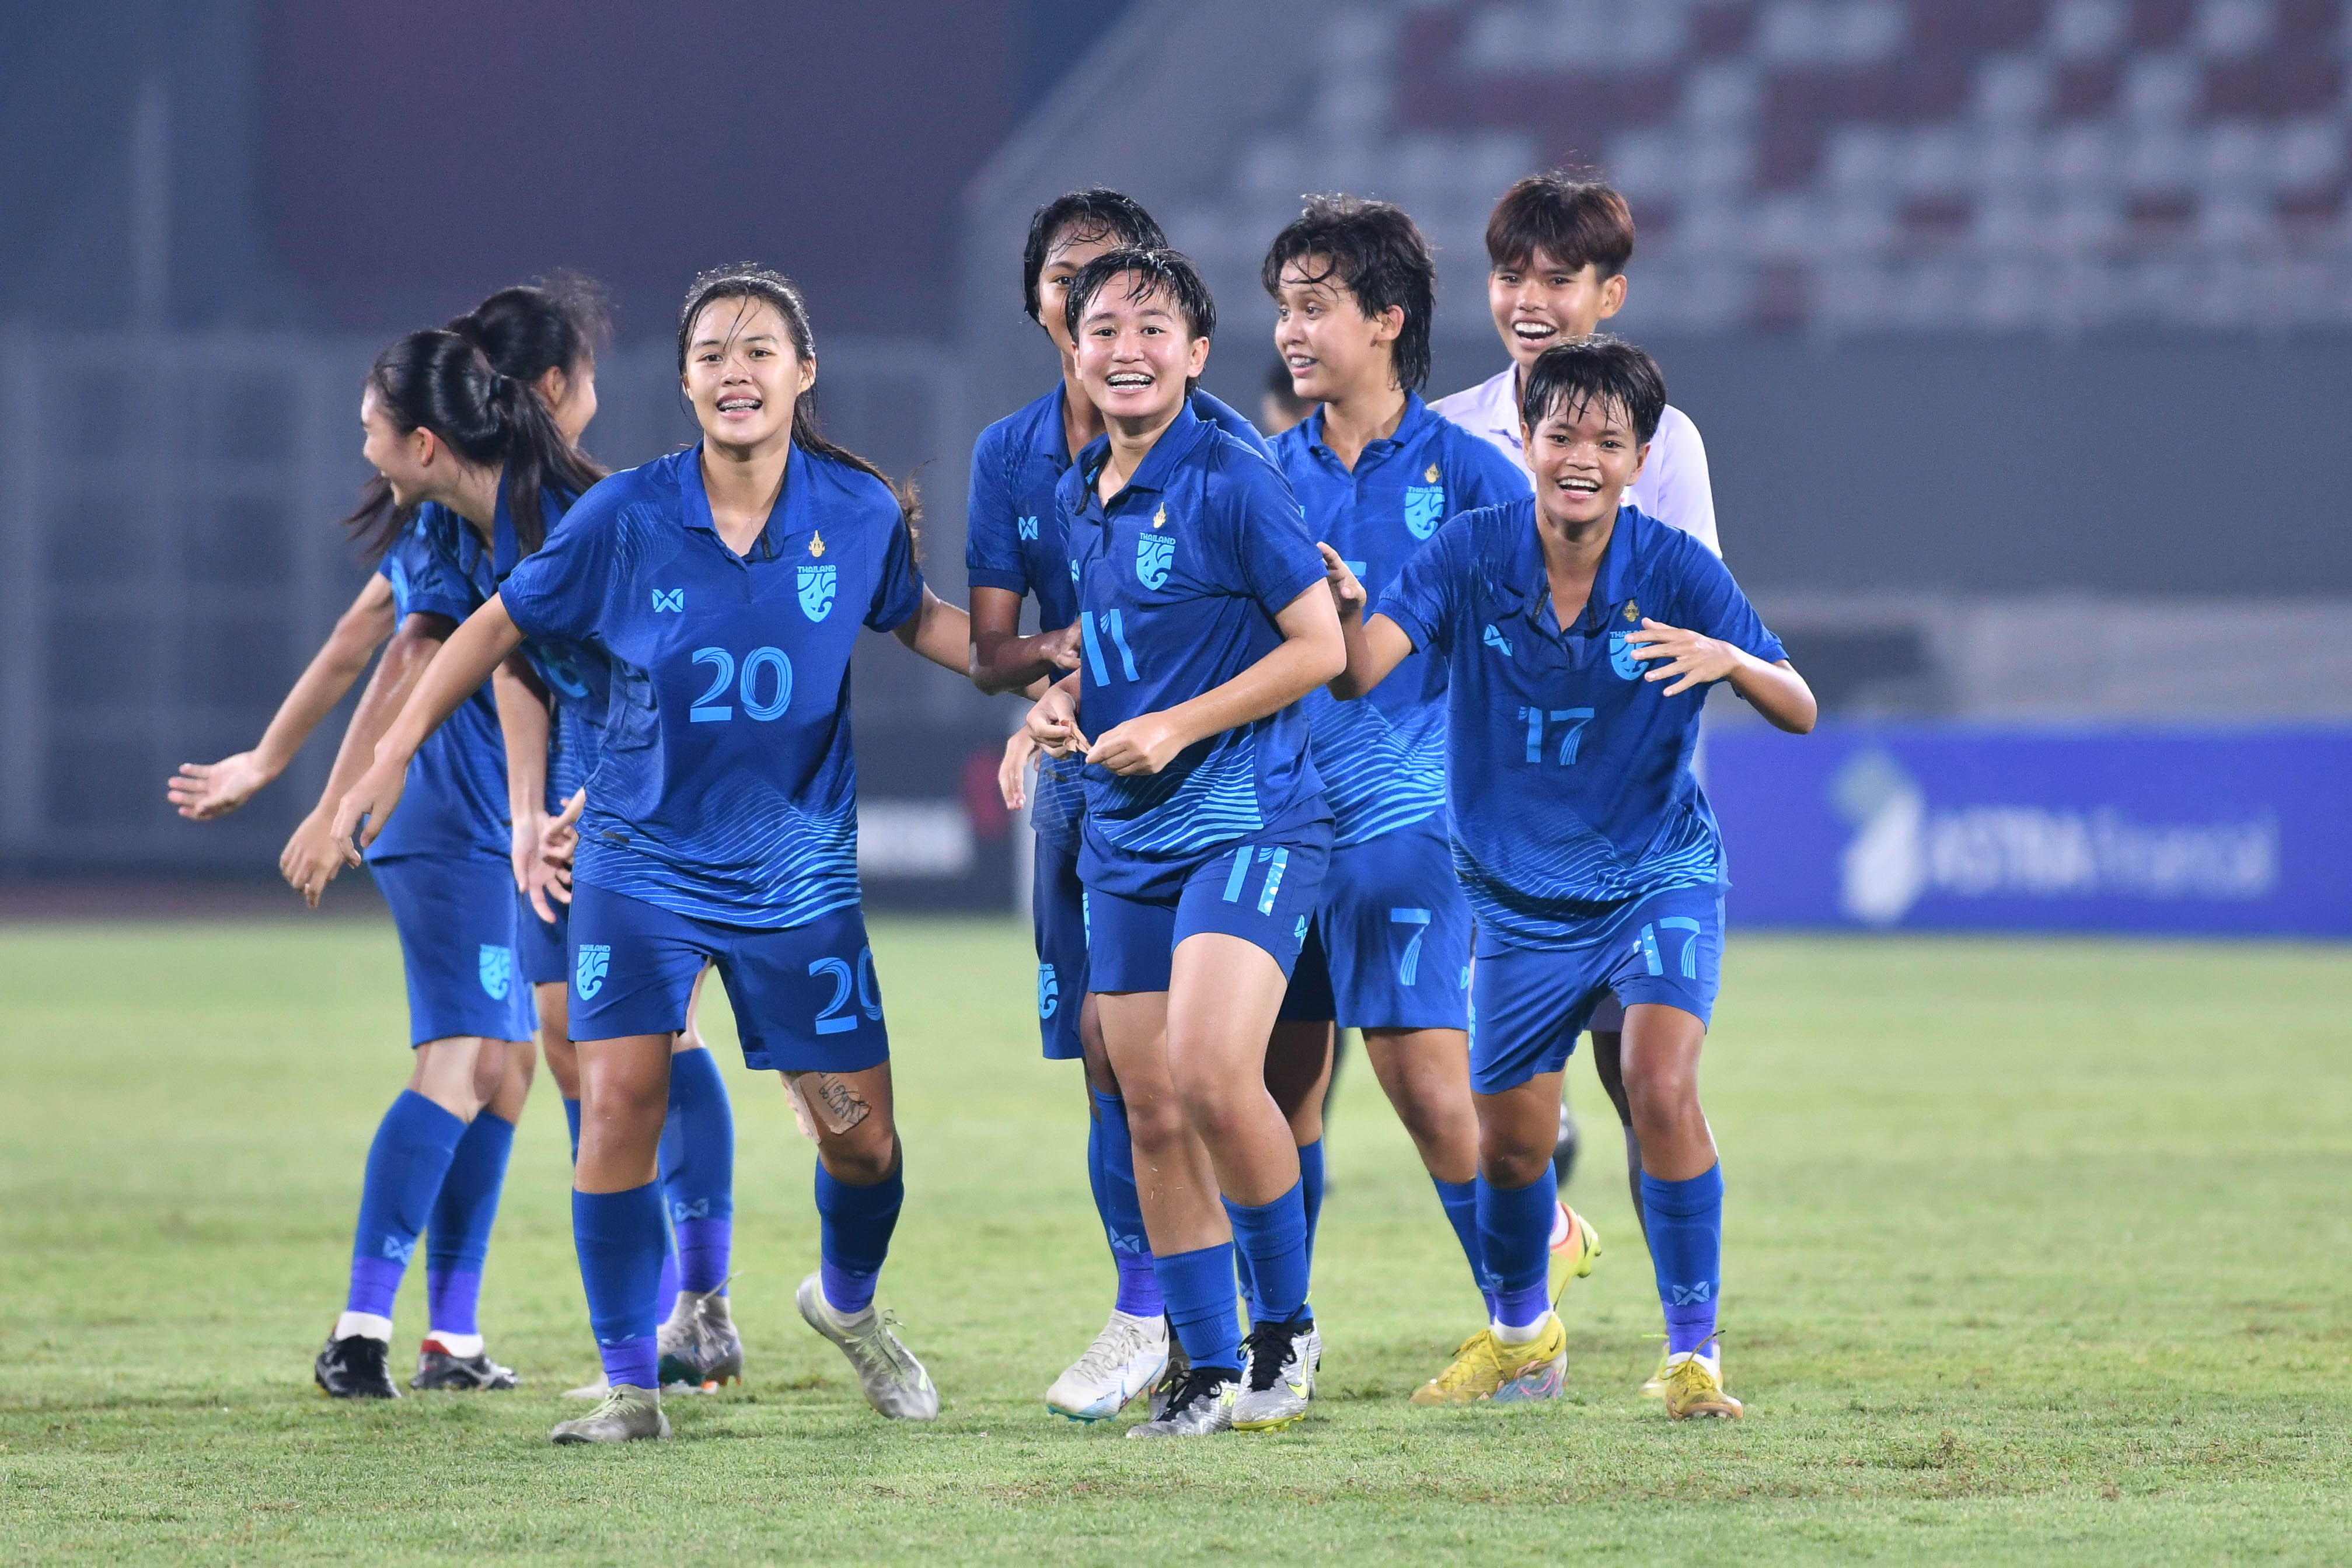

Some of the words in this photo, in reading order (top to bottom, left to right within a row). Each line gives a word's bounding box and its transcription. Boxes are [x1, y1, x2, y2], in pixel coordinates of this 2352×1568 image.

[797, 564, 836, 573] THAILAND
[1140, 532, 1176, 544] THAILAND
[690, 646, 793, 722] 20
[1081, 609, 1140, 687] 11
[1518, 706, 1594, 766] 17
[1222, 844, 1289, 917] 11
[1391, 908, 1432, 985] 7
[1634, 916, 1701, 980] 17
[809, 945, 882, 1035] 20
